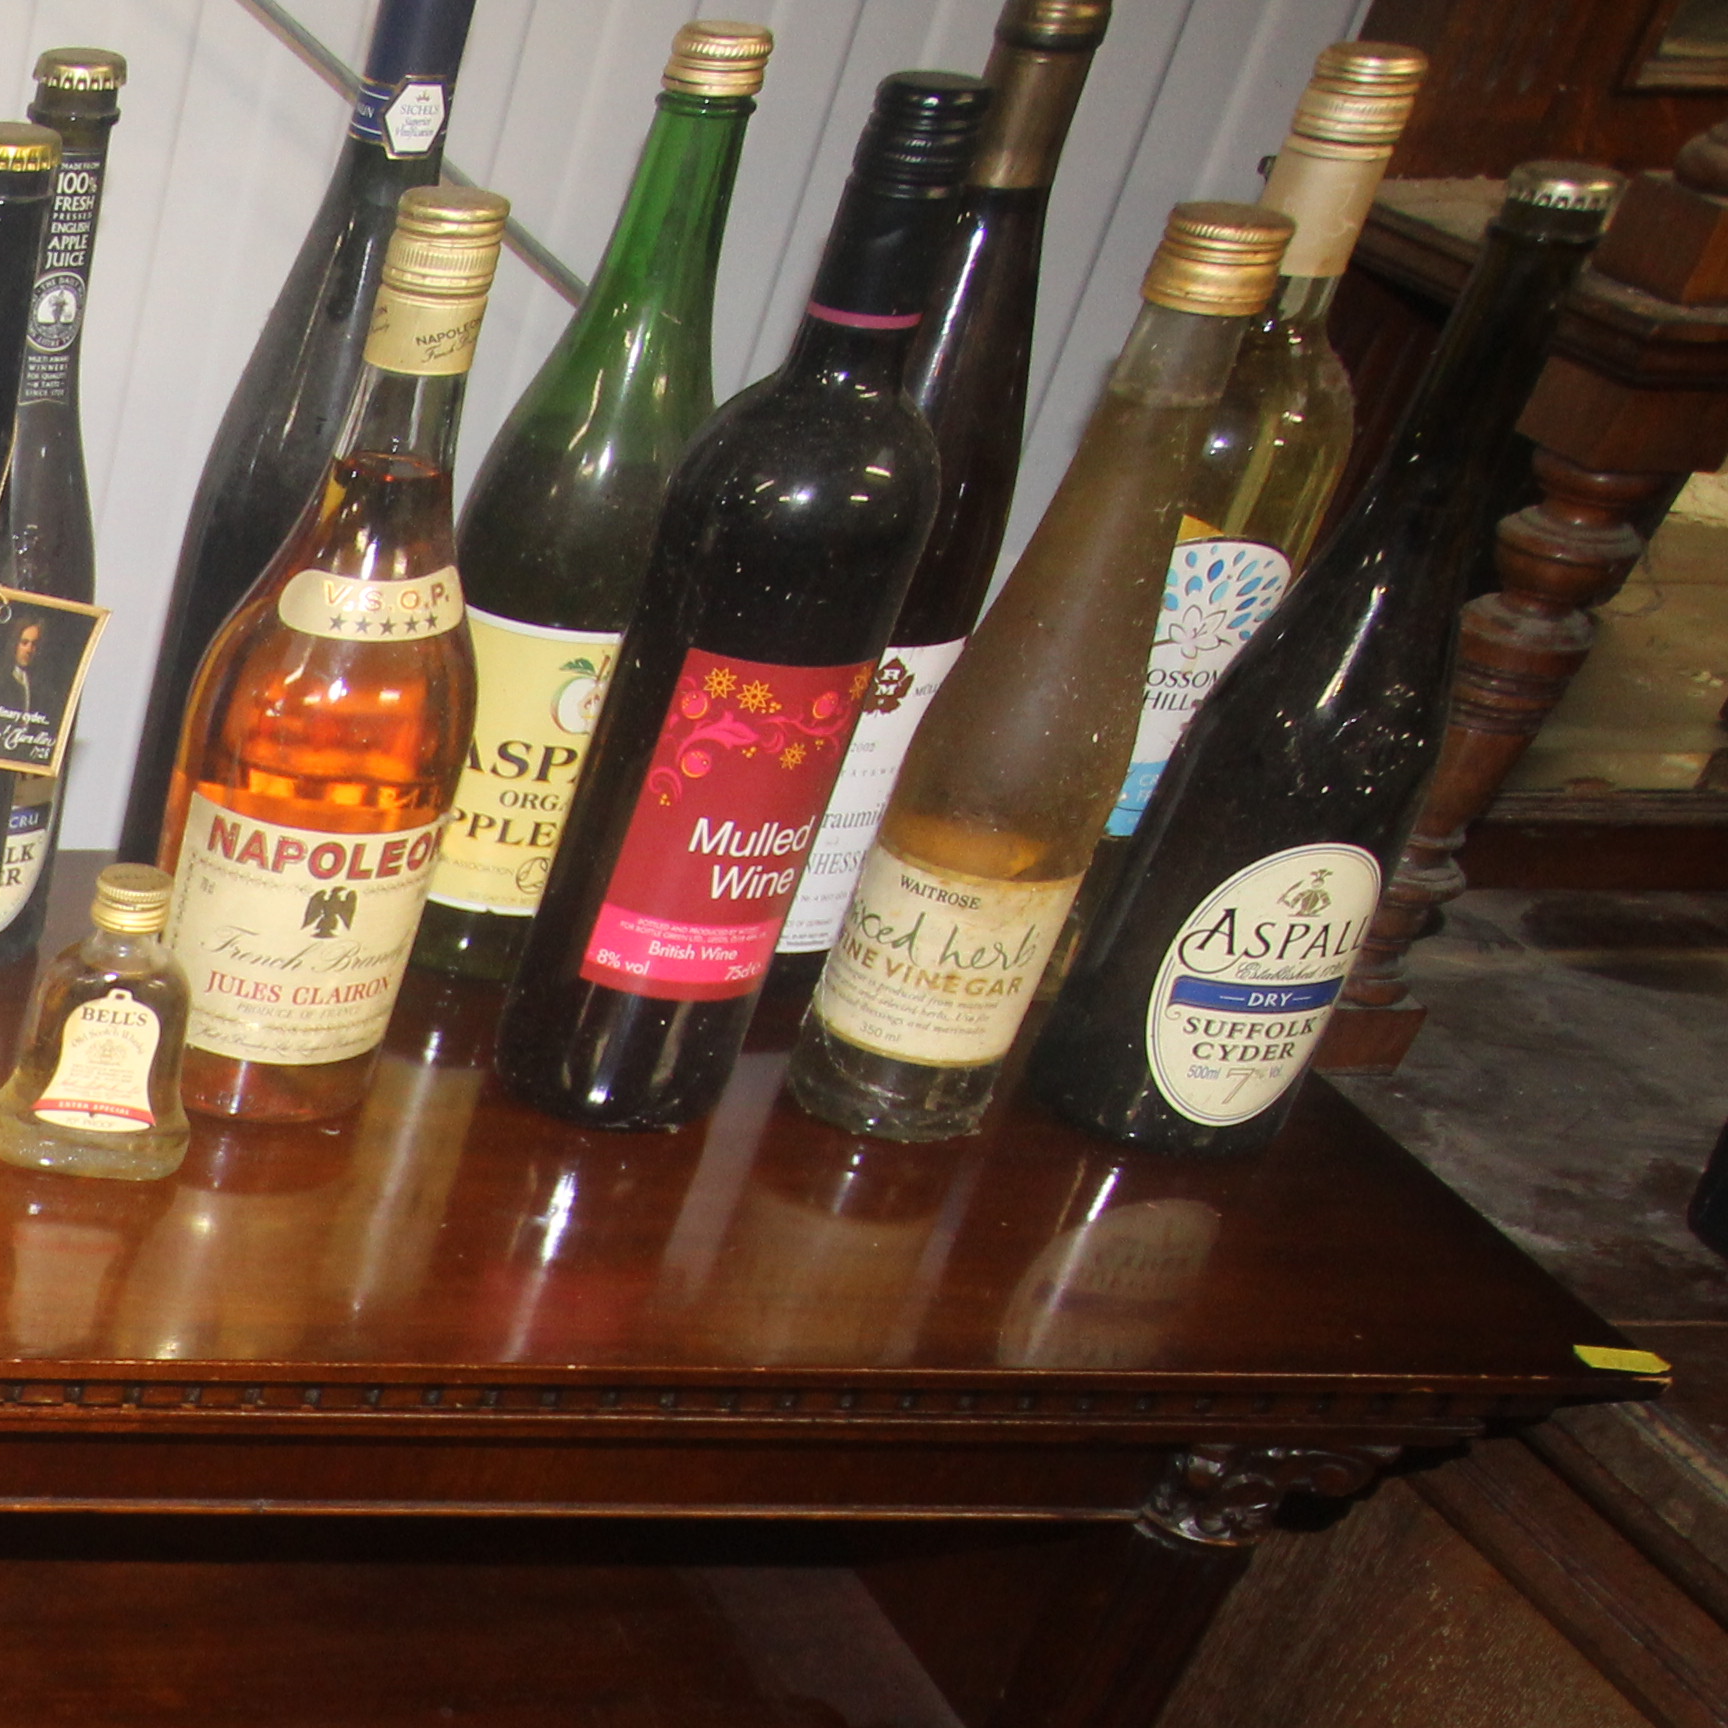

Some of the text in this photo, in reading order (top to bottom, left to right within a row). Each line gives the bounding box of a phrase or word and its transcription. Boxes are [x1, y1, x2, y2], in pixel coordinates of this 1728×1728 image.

[56, 172, 98, 194] 100%
[53, 195, 95, 212] FRESH
[51, 221, 92, 234] ENGLISH
[47, 234, 89, 251] APPLE
[45, 250, 86, 270] JUICE
[1143, 689, 1189, 711] HILL
[499, 789, 563, 813] ORG
[9, 812, 39, 830] CRU
[688, 814, 816, 858] Mulled
[711, 864, 795, 900] Wine
[900, 874, 981, 910] WAITROSE
[649, 941, 738, 961] British Wine
[1178, 907, 1369, 974] ASPALL
[597, 949, 651, 976] 8% vol
[886, 954, 1024, 997] VINEGAR
[205, 970, 392, 1006] JULES CLAIRON
[1247, 991, 1294, 1008] DRY
[81, 1006, 148, 1027] BELL'S
[859, 1020, 883, 1037] 350
[1182, 1016, 1318, 1041] SUFFOLK
[1192, 1041, 1296, 1064] CYDER
[1186, 1064, 1221, 1081] 500ml
